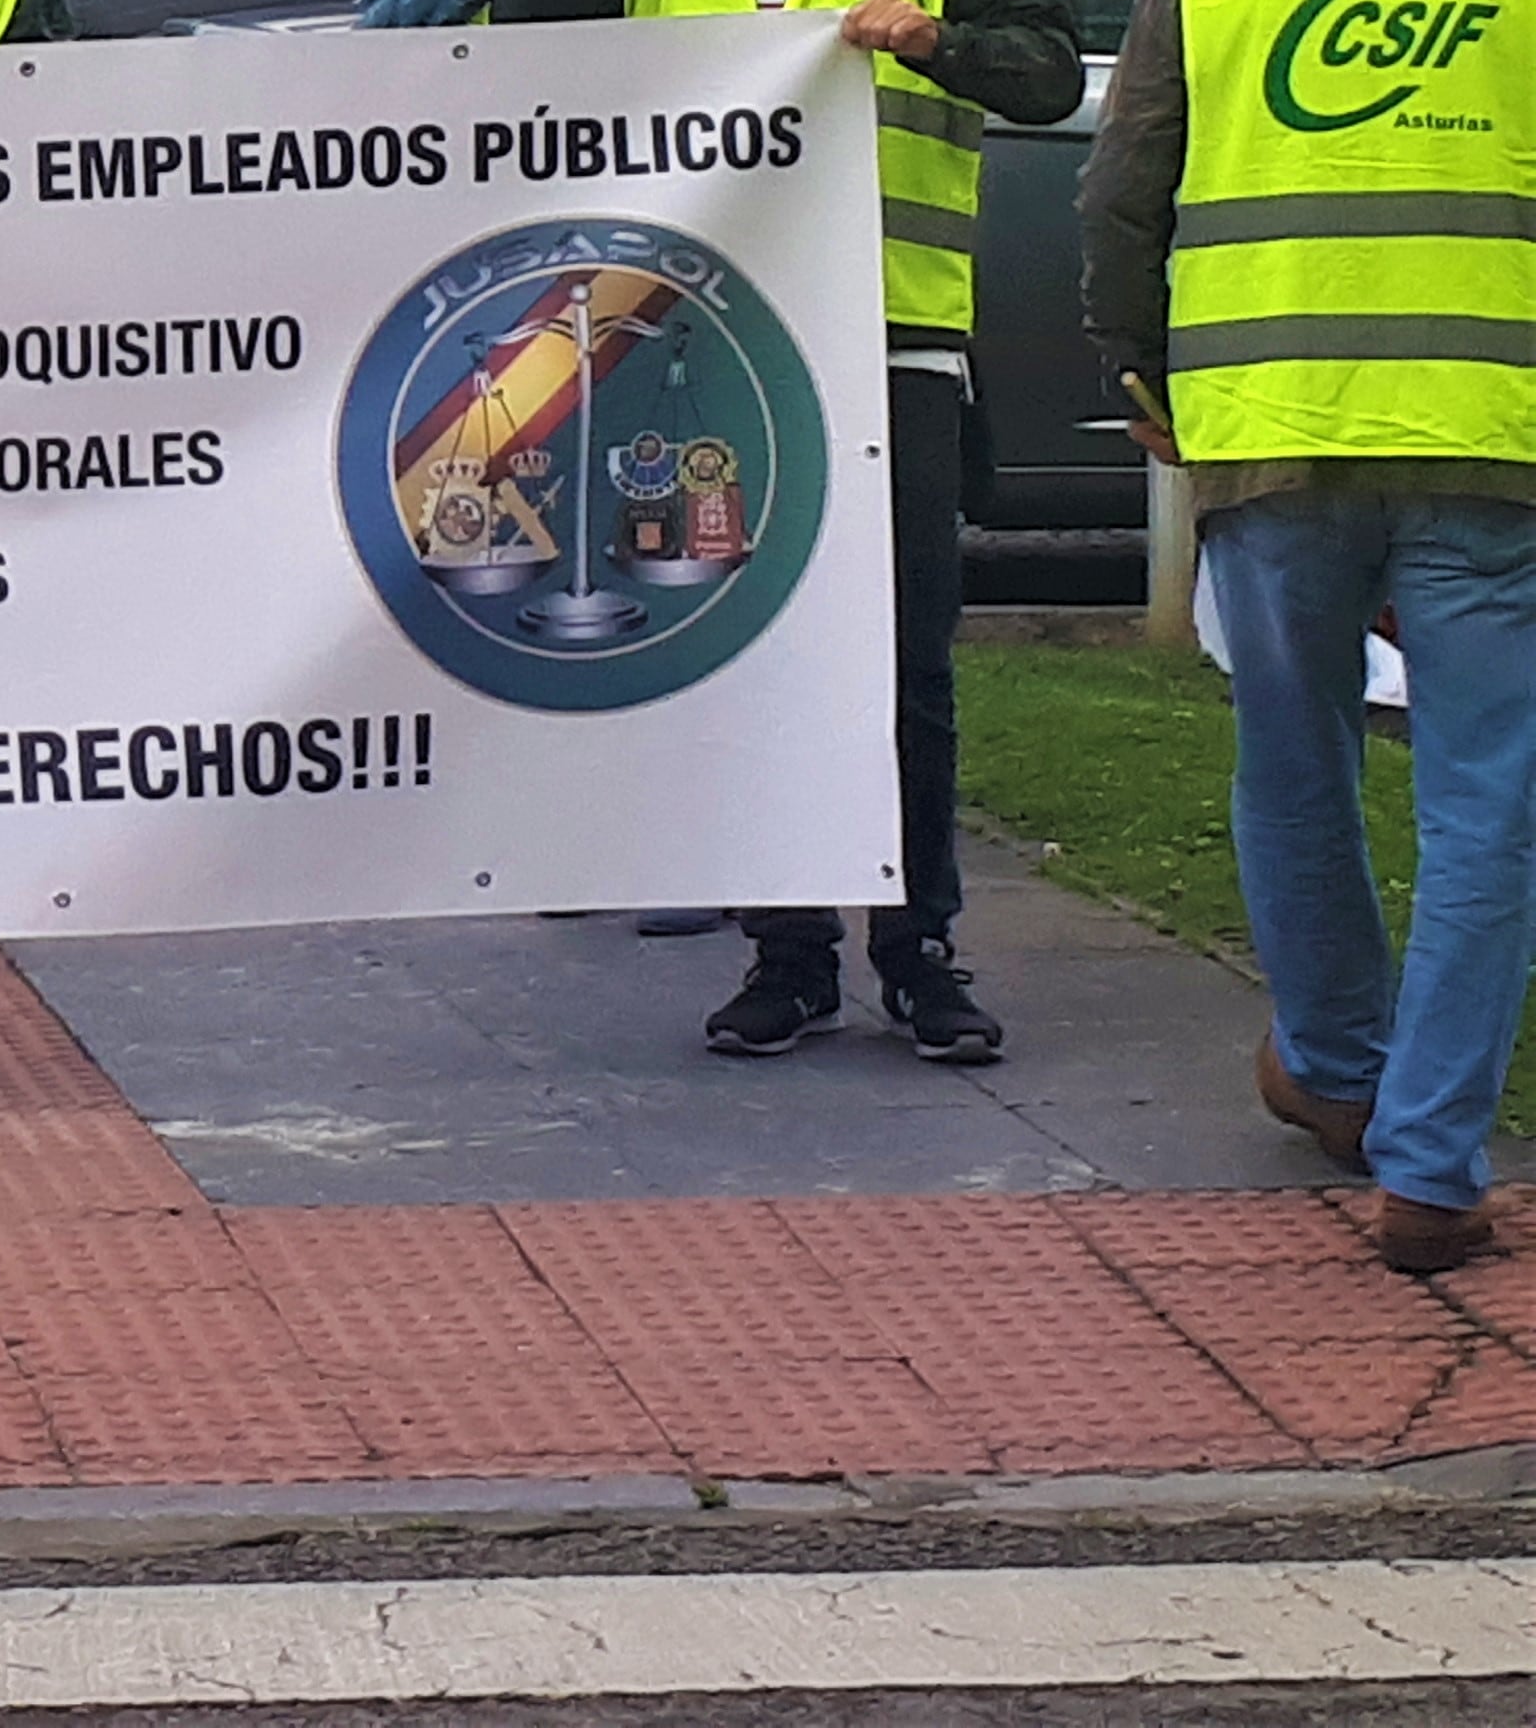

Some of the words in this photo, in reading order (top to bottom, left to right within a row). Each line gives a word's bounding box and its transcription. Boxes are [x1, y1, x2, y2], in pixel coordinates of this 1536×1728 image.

[1321, 1, 1500, 68] CSIF
[37, 124, 447, 202] EMPLEADOS
[474, 106, 803, 183] PÚBLICOS
[1393, 112, 1495, 132] Asturias
[423, 230, 730, 330] JUSAPOL
